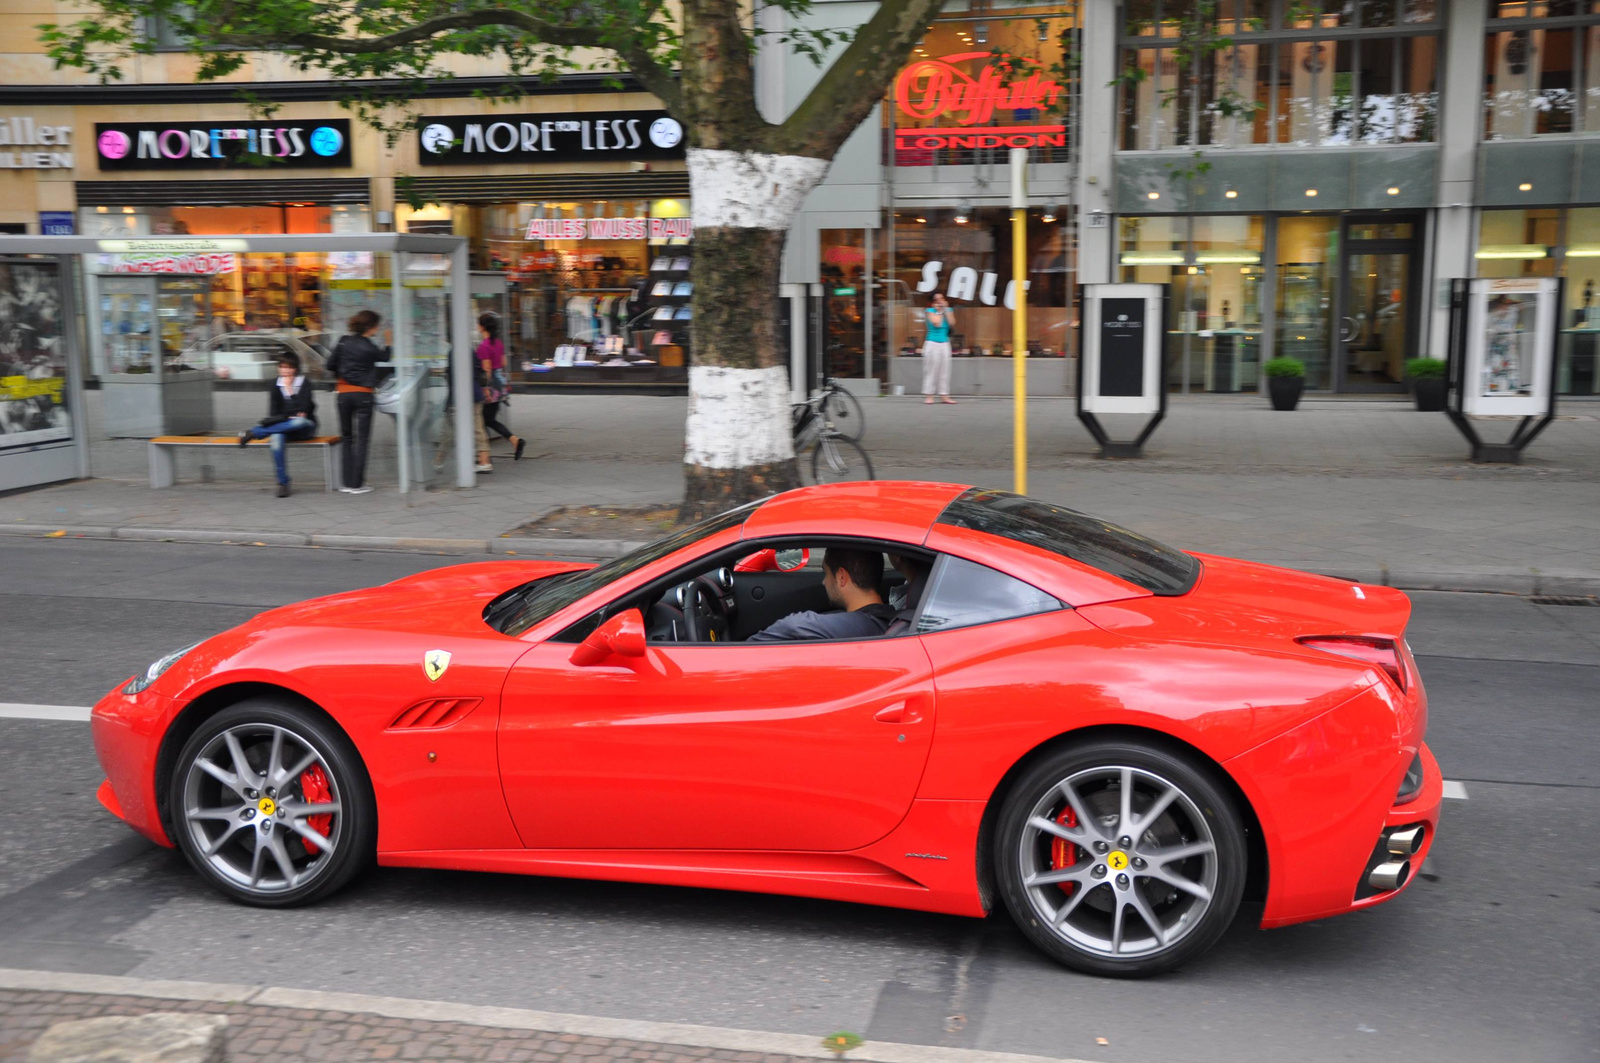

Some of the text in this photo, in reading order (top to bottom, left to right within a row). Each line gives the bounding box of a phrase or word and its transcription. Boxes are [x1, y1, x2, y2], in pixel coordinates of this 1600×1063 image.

[137, 129, 226, 159] MORE
[463, 119, 642, 153] MORE FOR LESS
[895, 134, 1066, 150] LONDON
[525, 218, 588, 240] ALLES
[587, 218, 648, 240] MUSS
